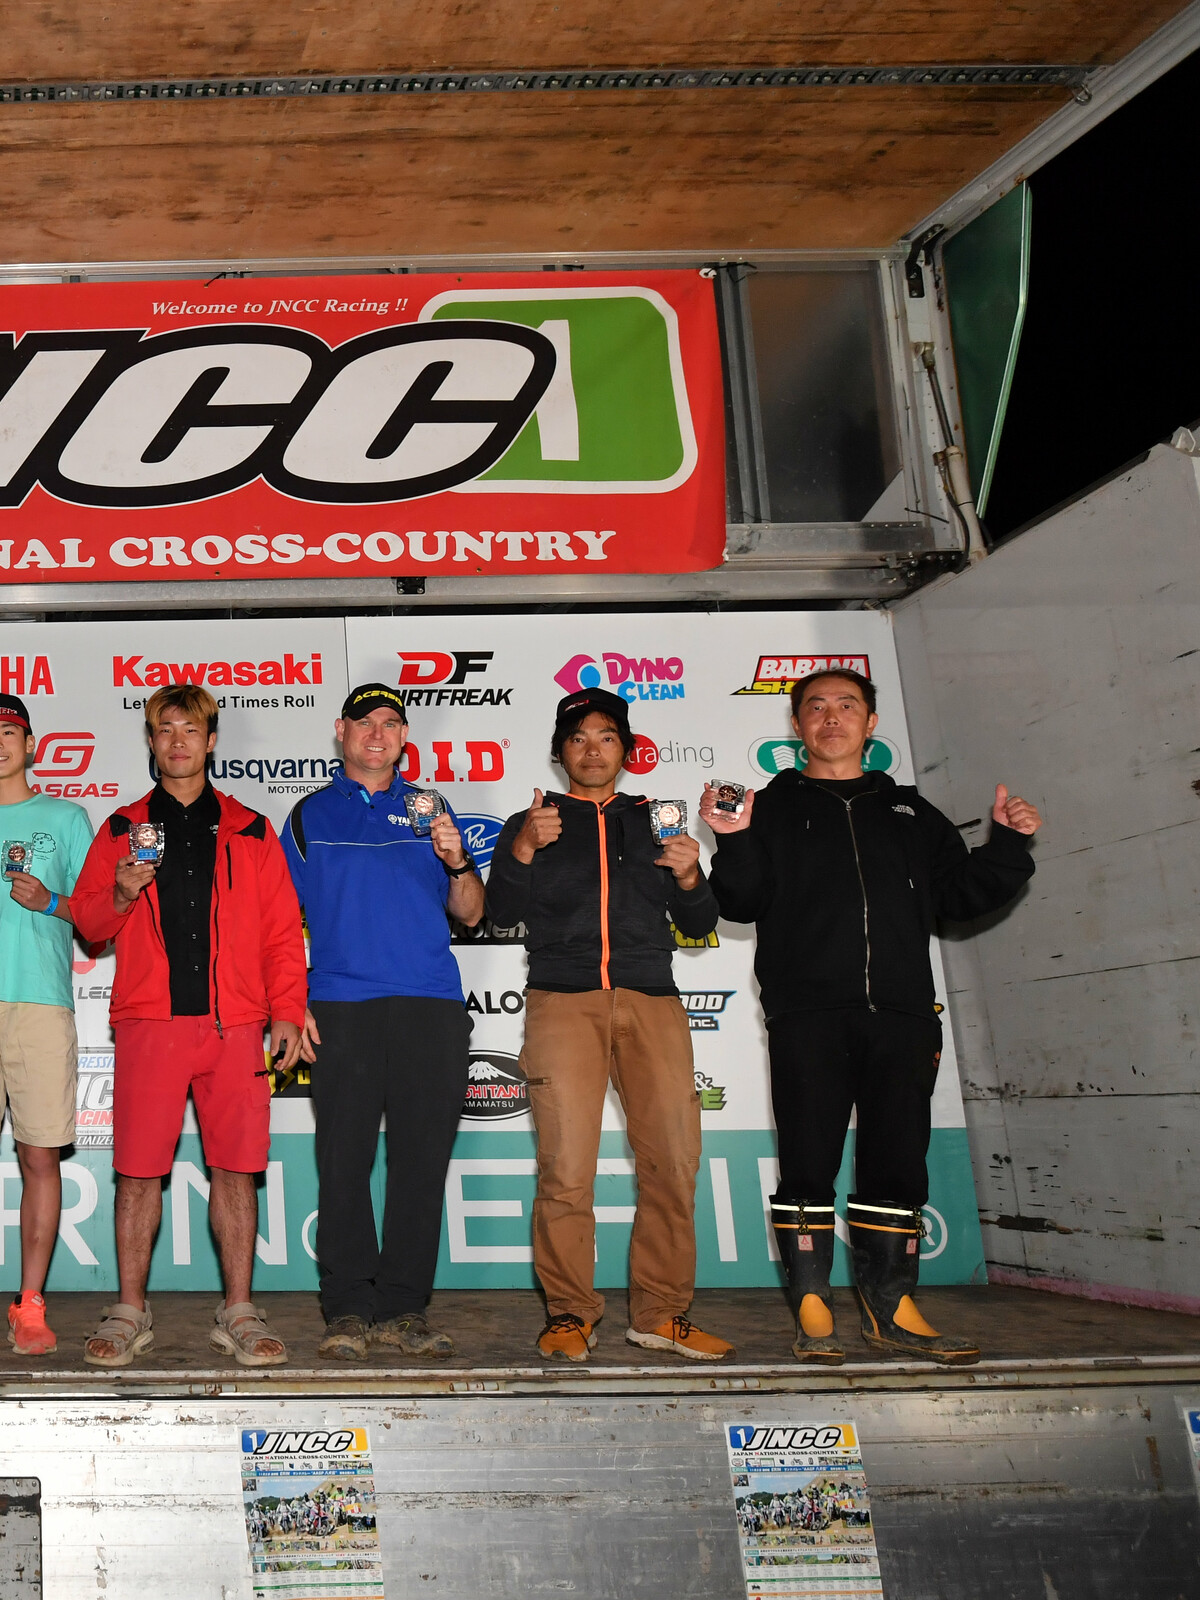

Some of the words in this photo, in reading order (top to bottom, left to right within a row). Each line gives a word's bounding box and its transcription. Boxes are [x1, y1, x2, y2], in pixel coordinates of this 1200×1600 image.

[151, 300, 238, 316] Welcome
[243, 300, 264, 315] to
[266, 299, 319, 316] JNCC
[324, 297, 390, 316] Racing
[109, 530, 617, 568] CROSS-COUNTRY
[112, 652, 323, 687] Kawasaki
[397, 650, 494, 685] DF
[602, 652, 684, 684] DYNO
[123, 697, 146, 710] Let
[231, 695, 279, 709] Times
[284, 695, 315, 708] Roll
[396, 688, 514, 706] IRTFREAK
[617, 681, 685, 704] CLEAN
[209, 758, 345, 783] usqvarna
[30, 782, 119, 798] ASGAS
[268, 785, 323, 794] MOTORCY
[464, 1084, 527, 1101] SHITANI
[253, 1431, 354, 1455] JNCC
[742, 1426, 842, 1451] JNCC
